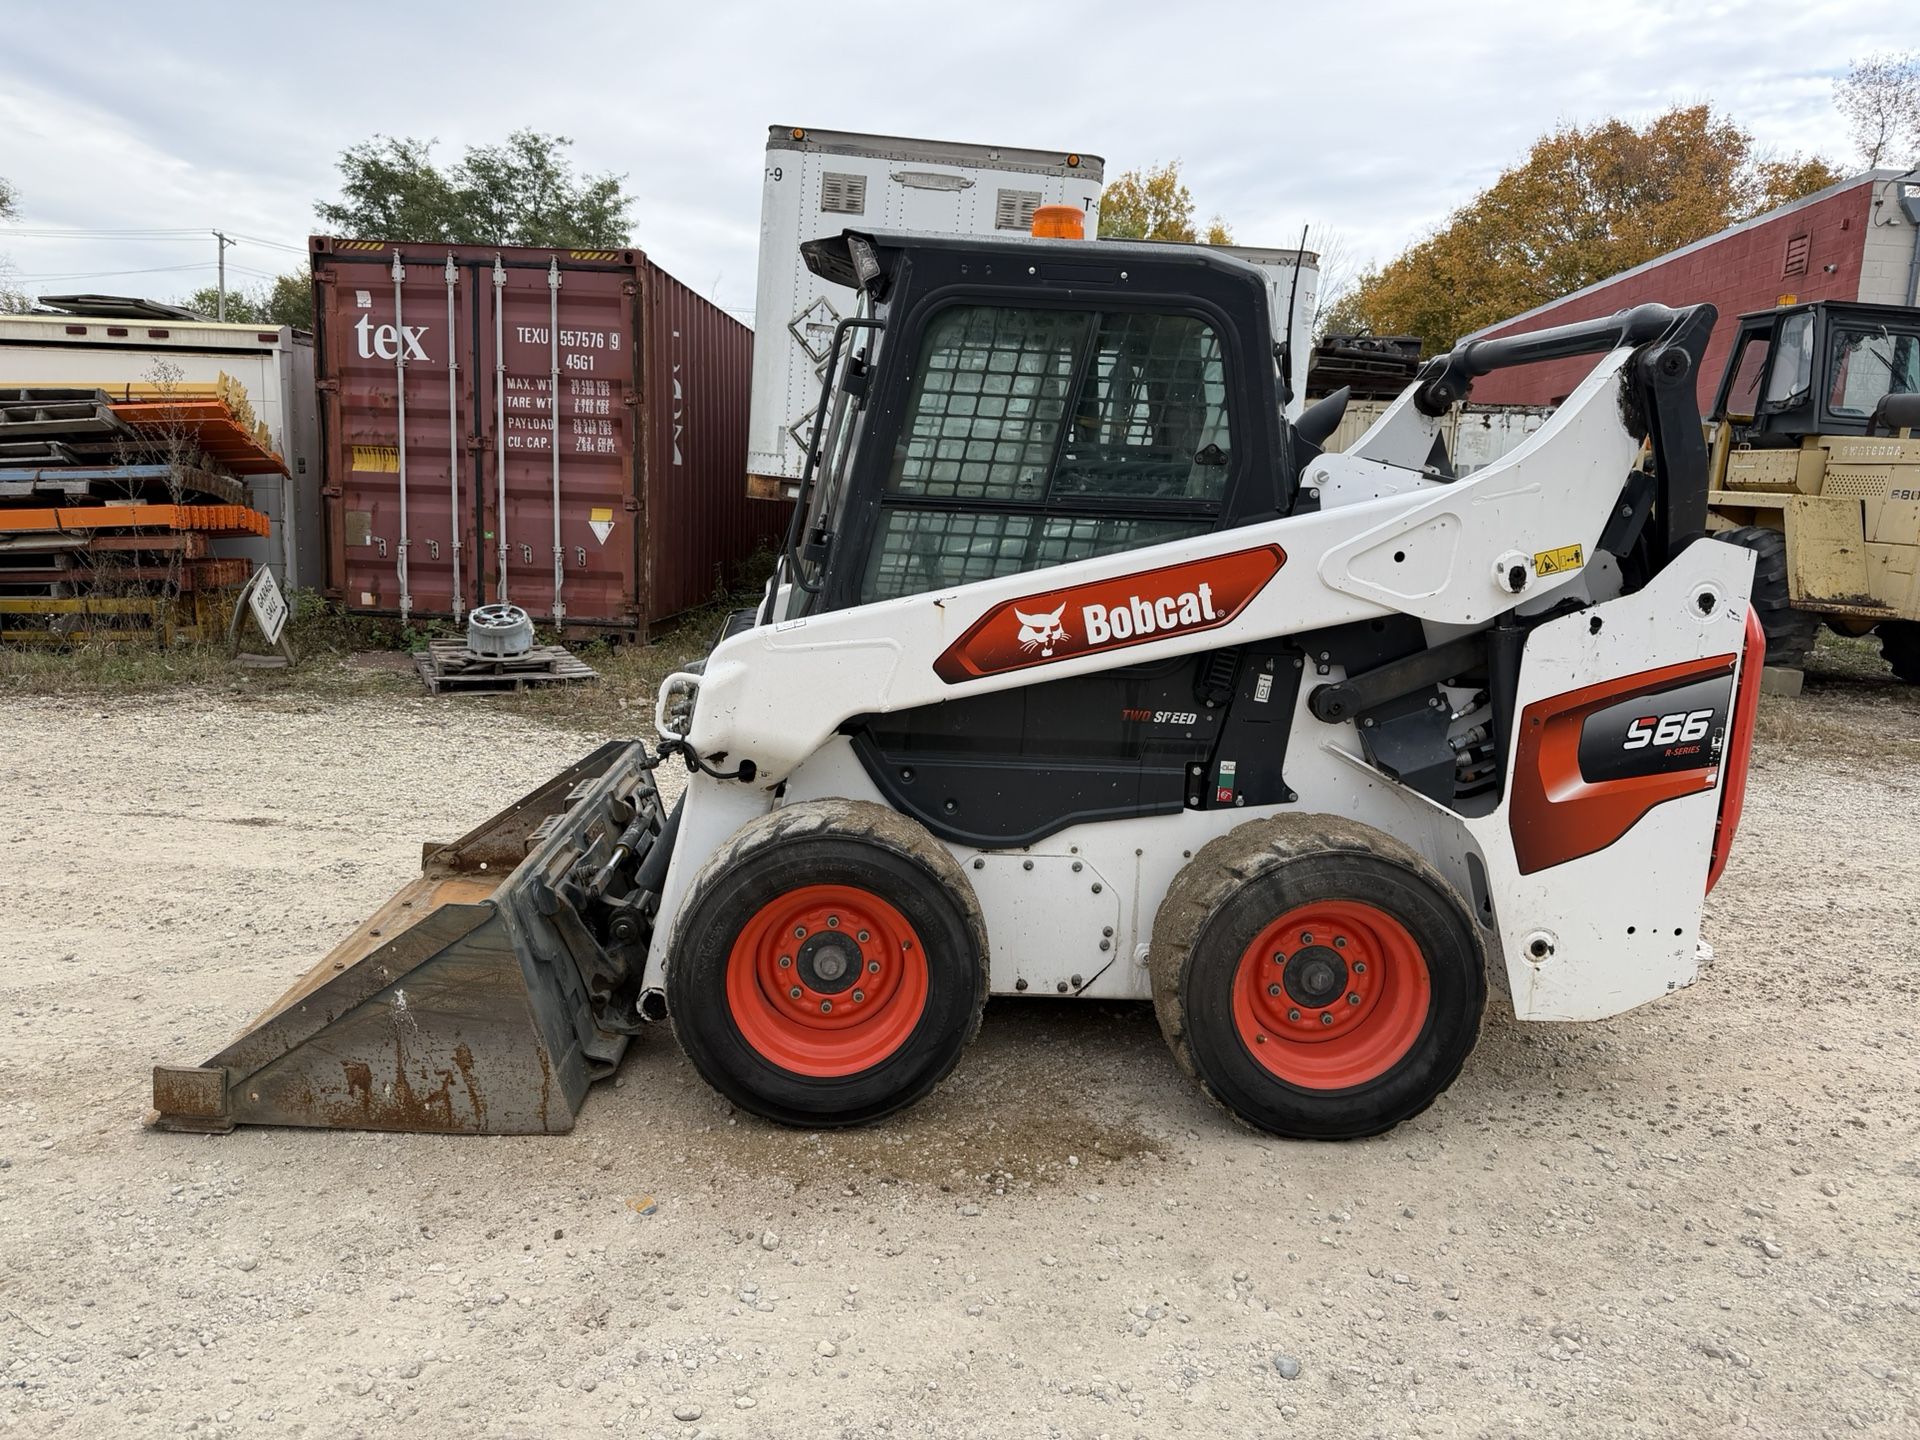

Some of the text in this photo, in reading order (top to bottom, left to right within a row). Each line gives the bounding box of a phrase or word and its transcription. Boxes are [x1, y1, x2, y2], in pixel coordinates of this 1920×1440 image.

[354, 313, 431, 360] tex
[517, 327, 620, 350] TEXU 557576 9
[566, 354, 594, 371] 45G1
[506, 378, 534, 391] MAX.
[597, 388, 610, 397] LBS
[506, 396, 531, 408] TARE
[596, 406, 609, 414] LBS
[508, 417, 554, 430] PAYLOAD
[599, 427, 612, 435] LBS
[508, 436, 551, 449] CU. CAP.
[257, 575, 273, 609] GARAGE
[265, 596, 278, 621] SALE
[1082, 582, 1216, 645] Bobcat
[1121, 709, 1198, 725] TWO SPEED
[1623, 709, 1714, 750] S66
[1664, 745, 1701, 757] R-SERIES
